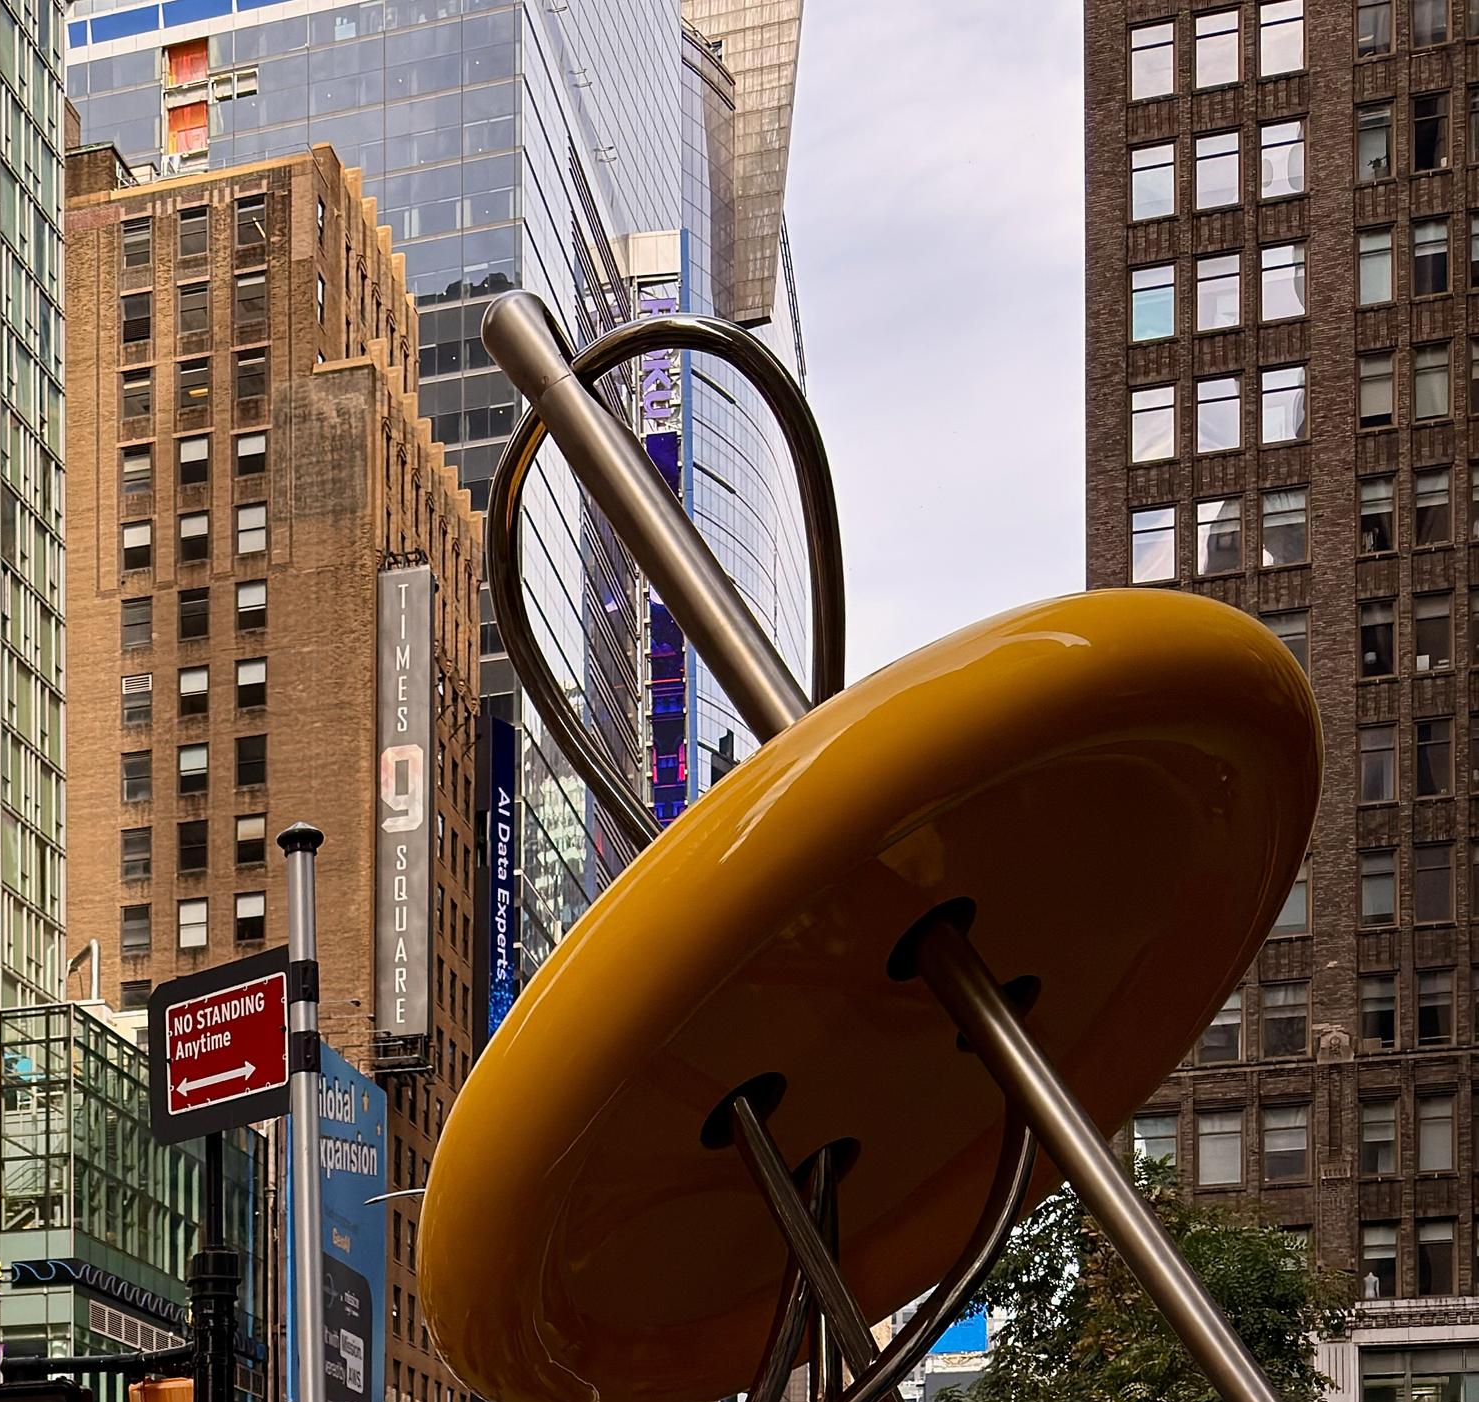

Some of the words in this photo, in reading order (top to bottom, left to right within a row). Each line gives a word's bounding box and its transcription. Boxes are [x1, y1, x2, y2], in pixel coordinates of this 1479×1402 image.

[640, 298, 676, 419] RKU
[395, 583, 411, 733] TIMES
[381, 744, 424, 833] 9
[496, 787, 510, 818] AI
[496, 825, 509, 883] Data
[393, 845, 408, 1024] SQUARE
[494, 889, 509, 982] Experts
[174, 1013, 193, 1036] NO
[197, 992, 265, 1030] STANDING
[176, 1031, 232, 1060] Anytime
[321, 1132, 378, 1179] xpansion
